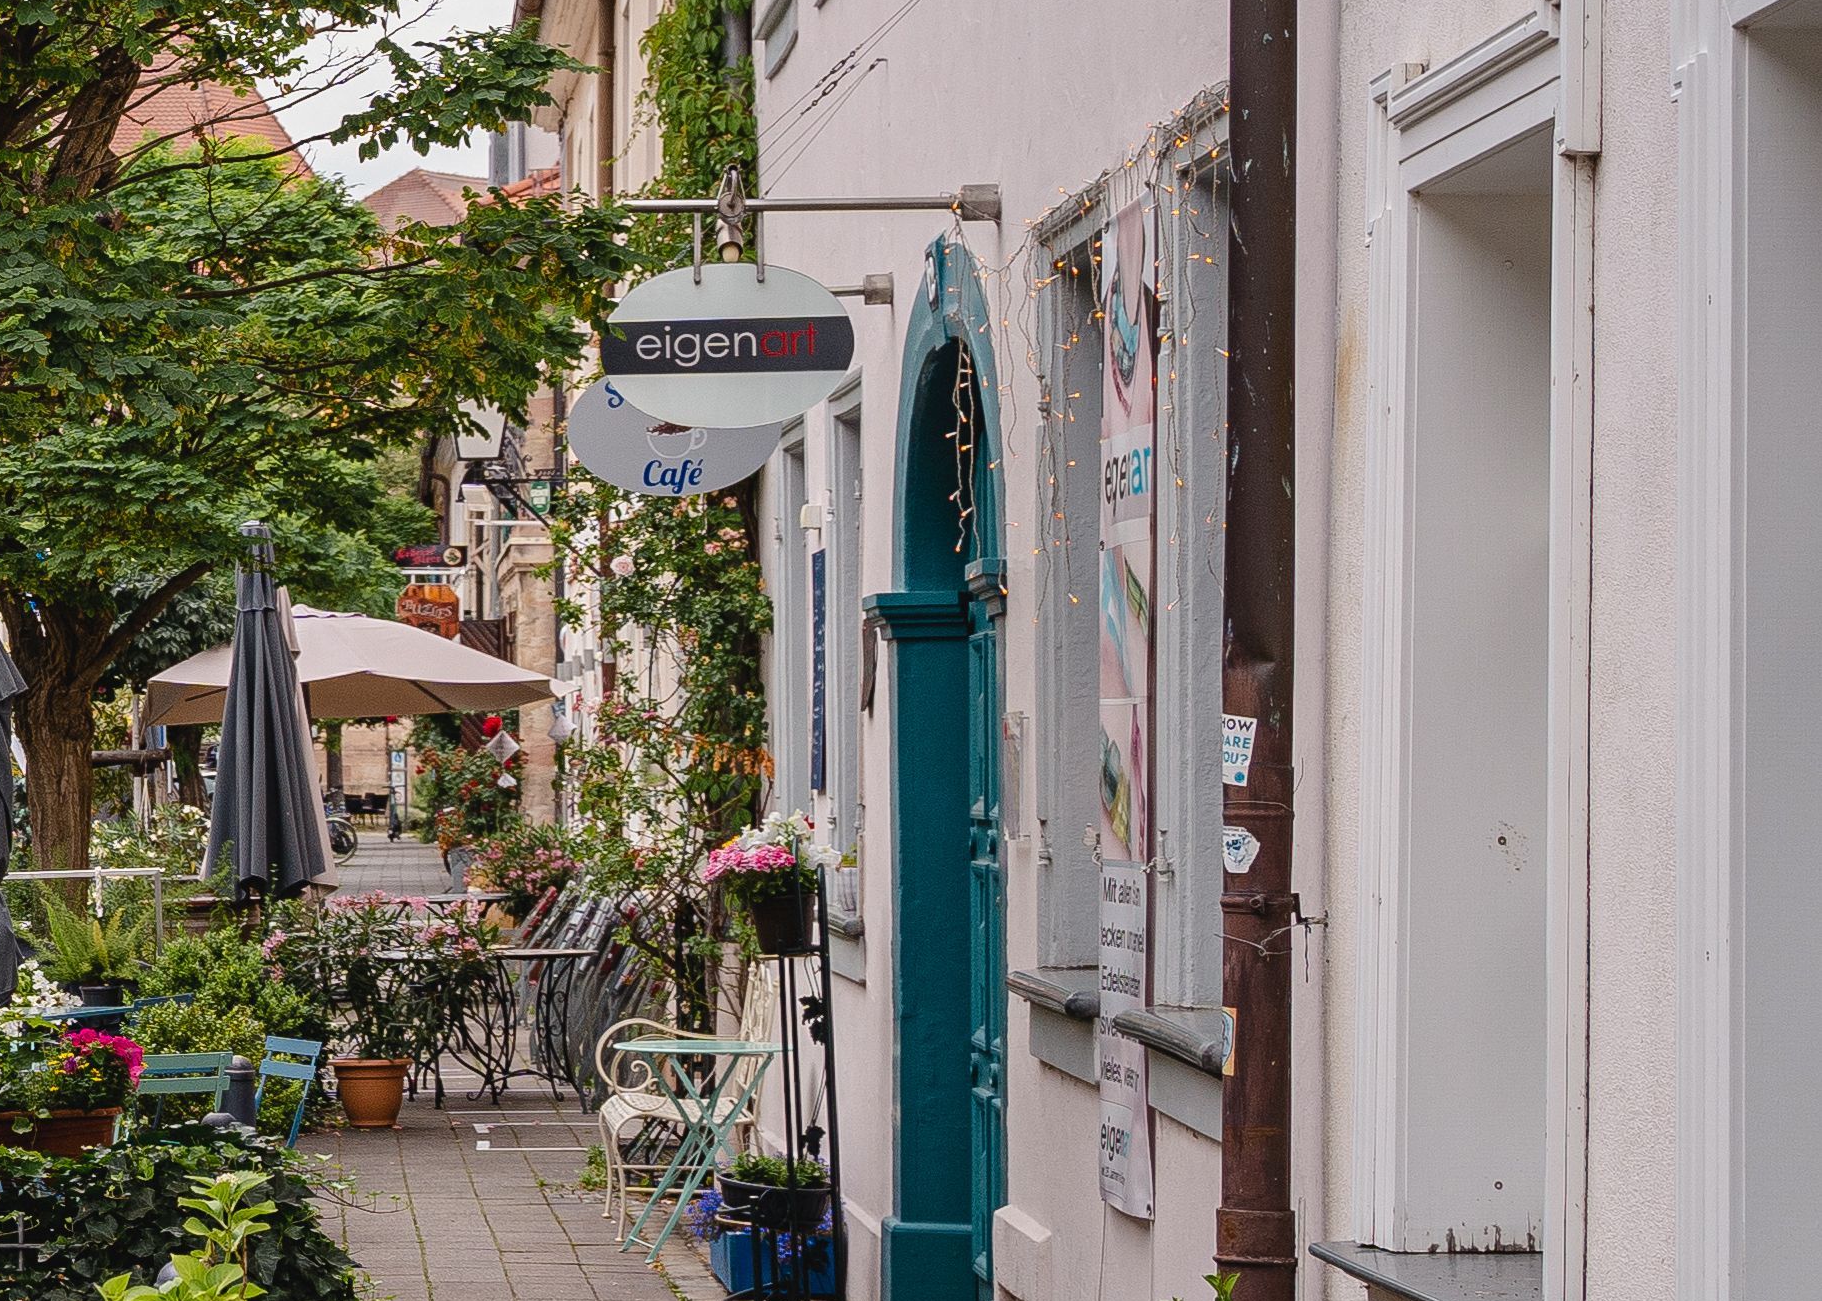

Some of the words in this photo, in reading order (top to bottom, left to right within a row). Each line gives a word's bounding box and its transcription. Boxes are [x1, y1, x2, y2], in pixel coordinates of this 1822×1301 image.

[636, 321, 820, 368] eigenart
[643, 458, 704, 495] Café
[1222, 734, 1251, 750] ARE
[1223, 751, 1249, 766] OU?
[1103, 877, 1117, 903] Mit
